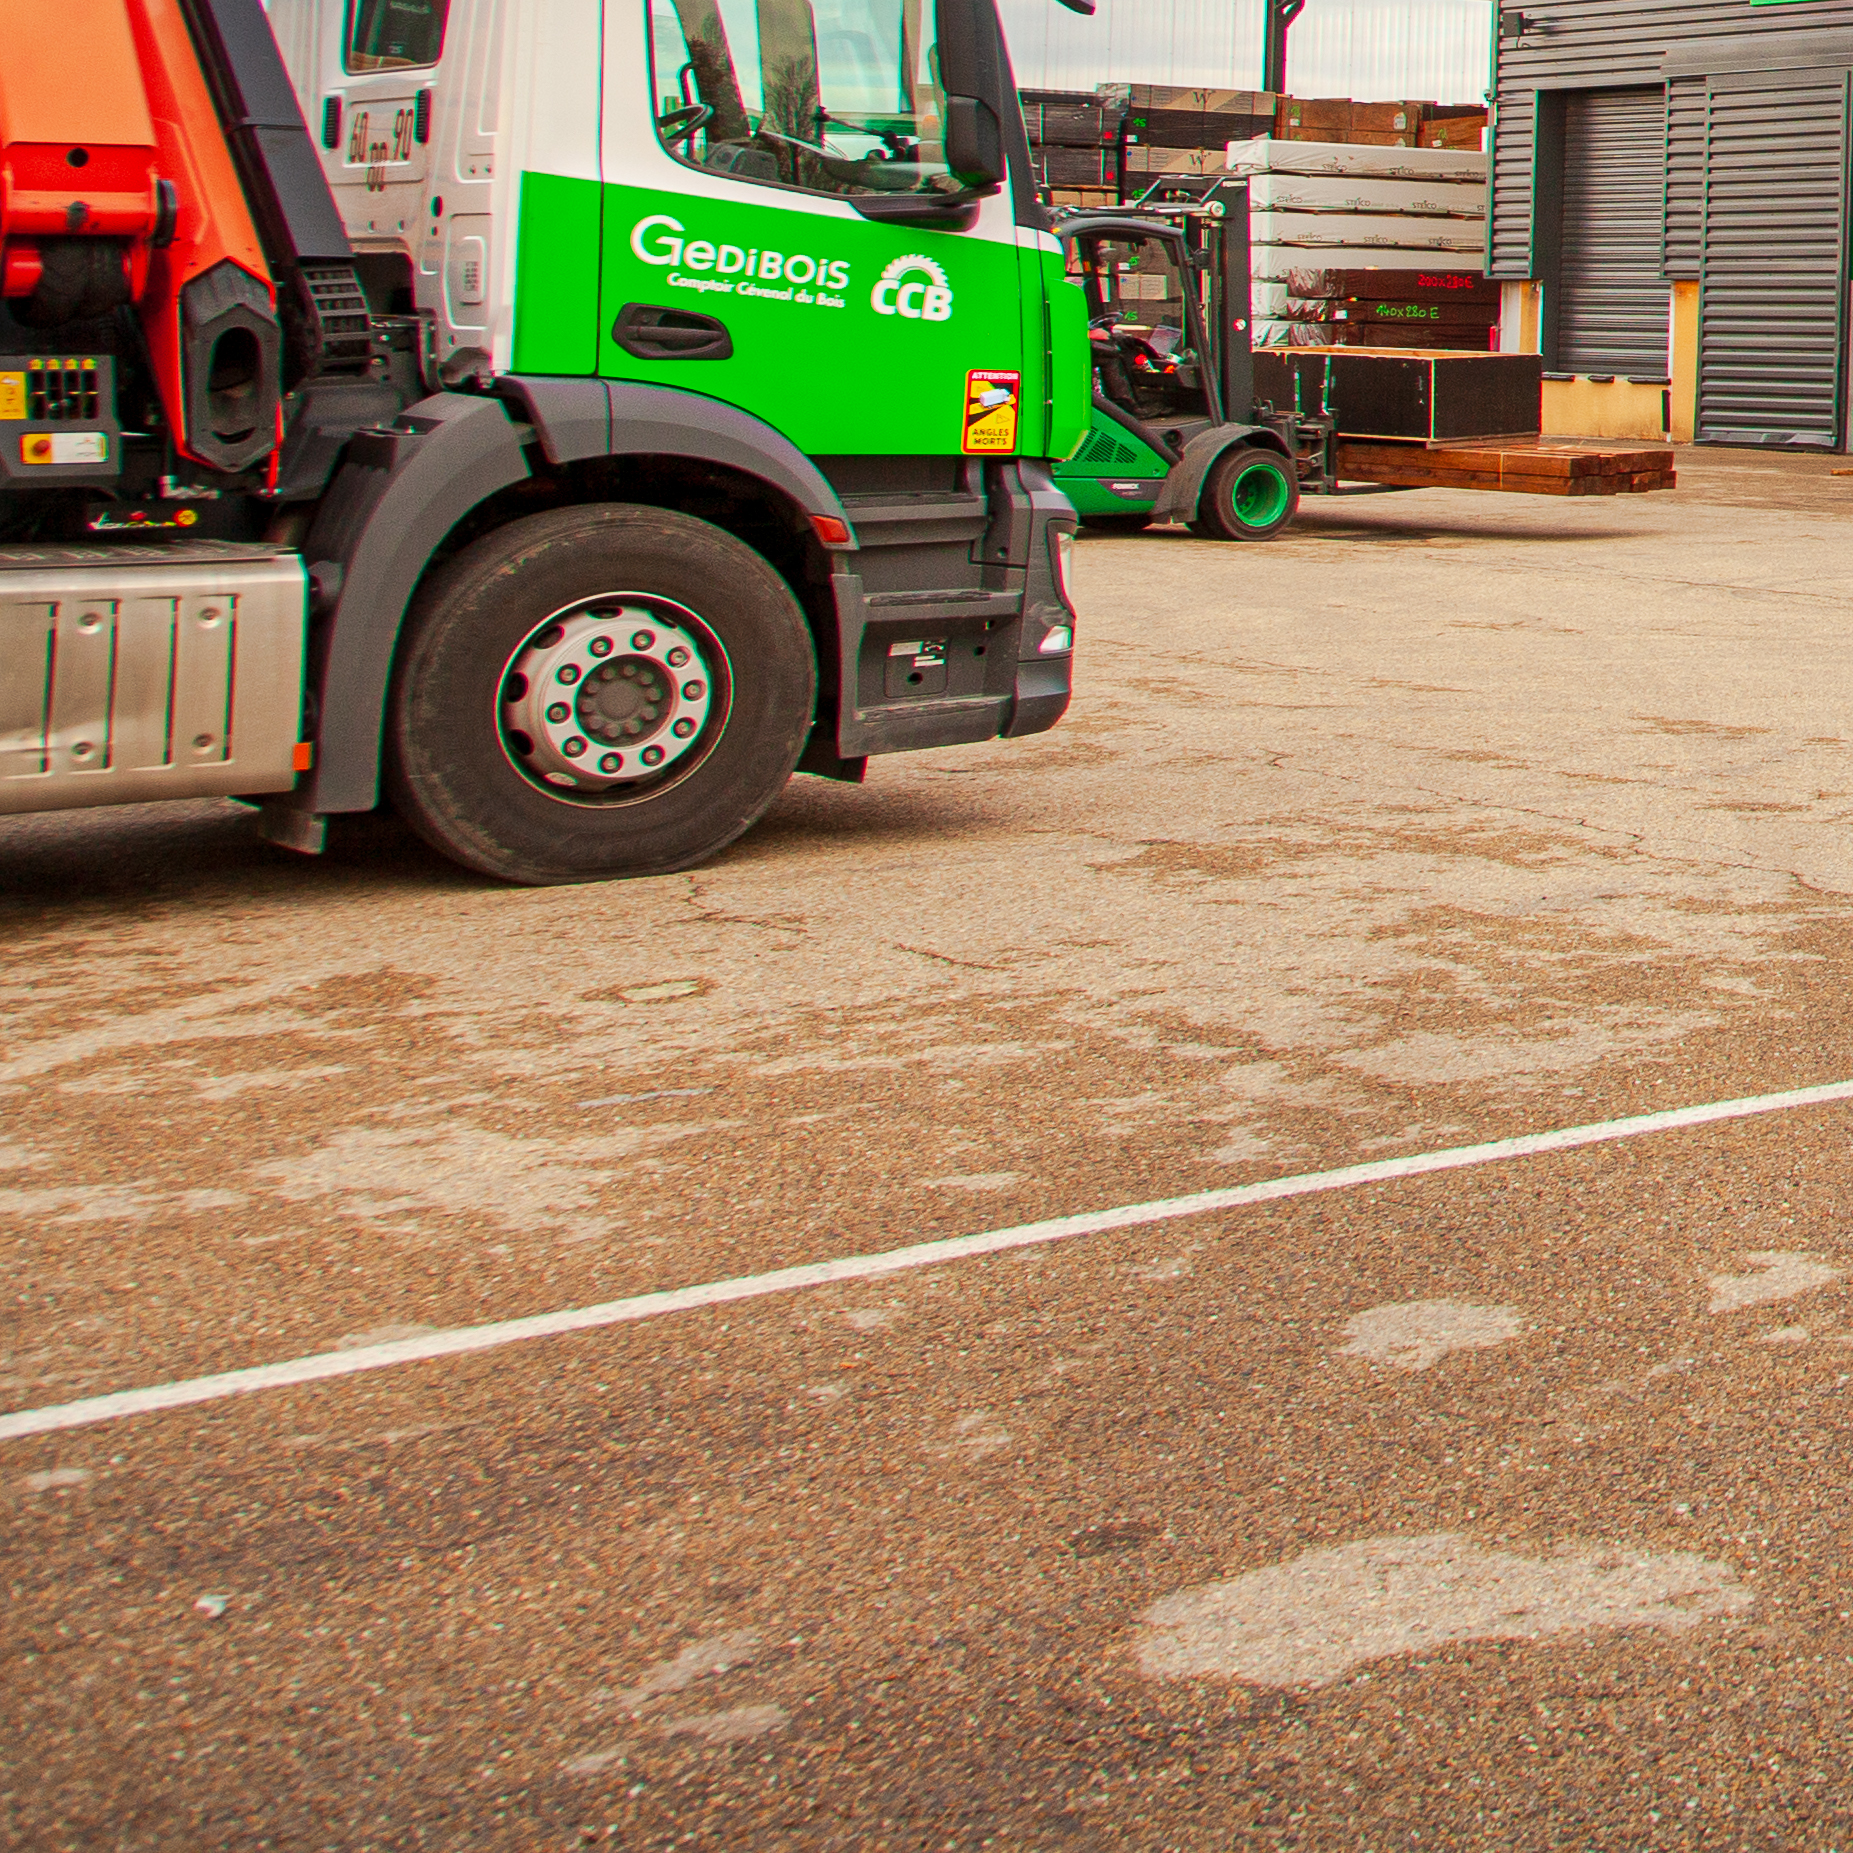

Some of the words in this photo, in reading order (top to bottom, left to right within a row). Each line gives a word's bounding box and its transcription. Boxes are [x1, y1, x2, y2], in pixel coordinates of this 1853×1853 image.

[394, 109, 414, 160] 90
[666, 272, 735, 293] Comptoir
[736, 281, 793, 301] Cévenol
[794, 288, 813, 304] du
[816, 292, 845, 308] Bois
[870, 277, 953, 322] CCB
[972, 428, 1010, 437] ANGLES
[973, 437, 1007, 445] MORTS
